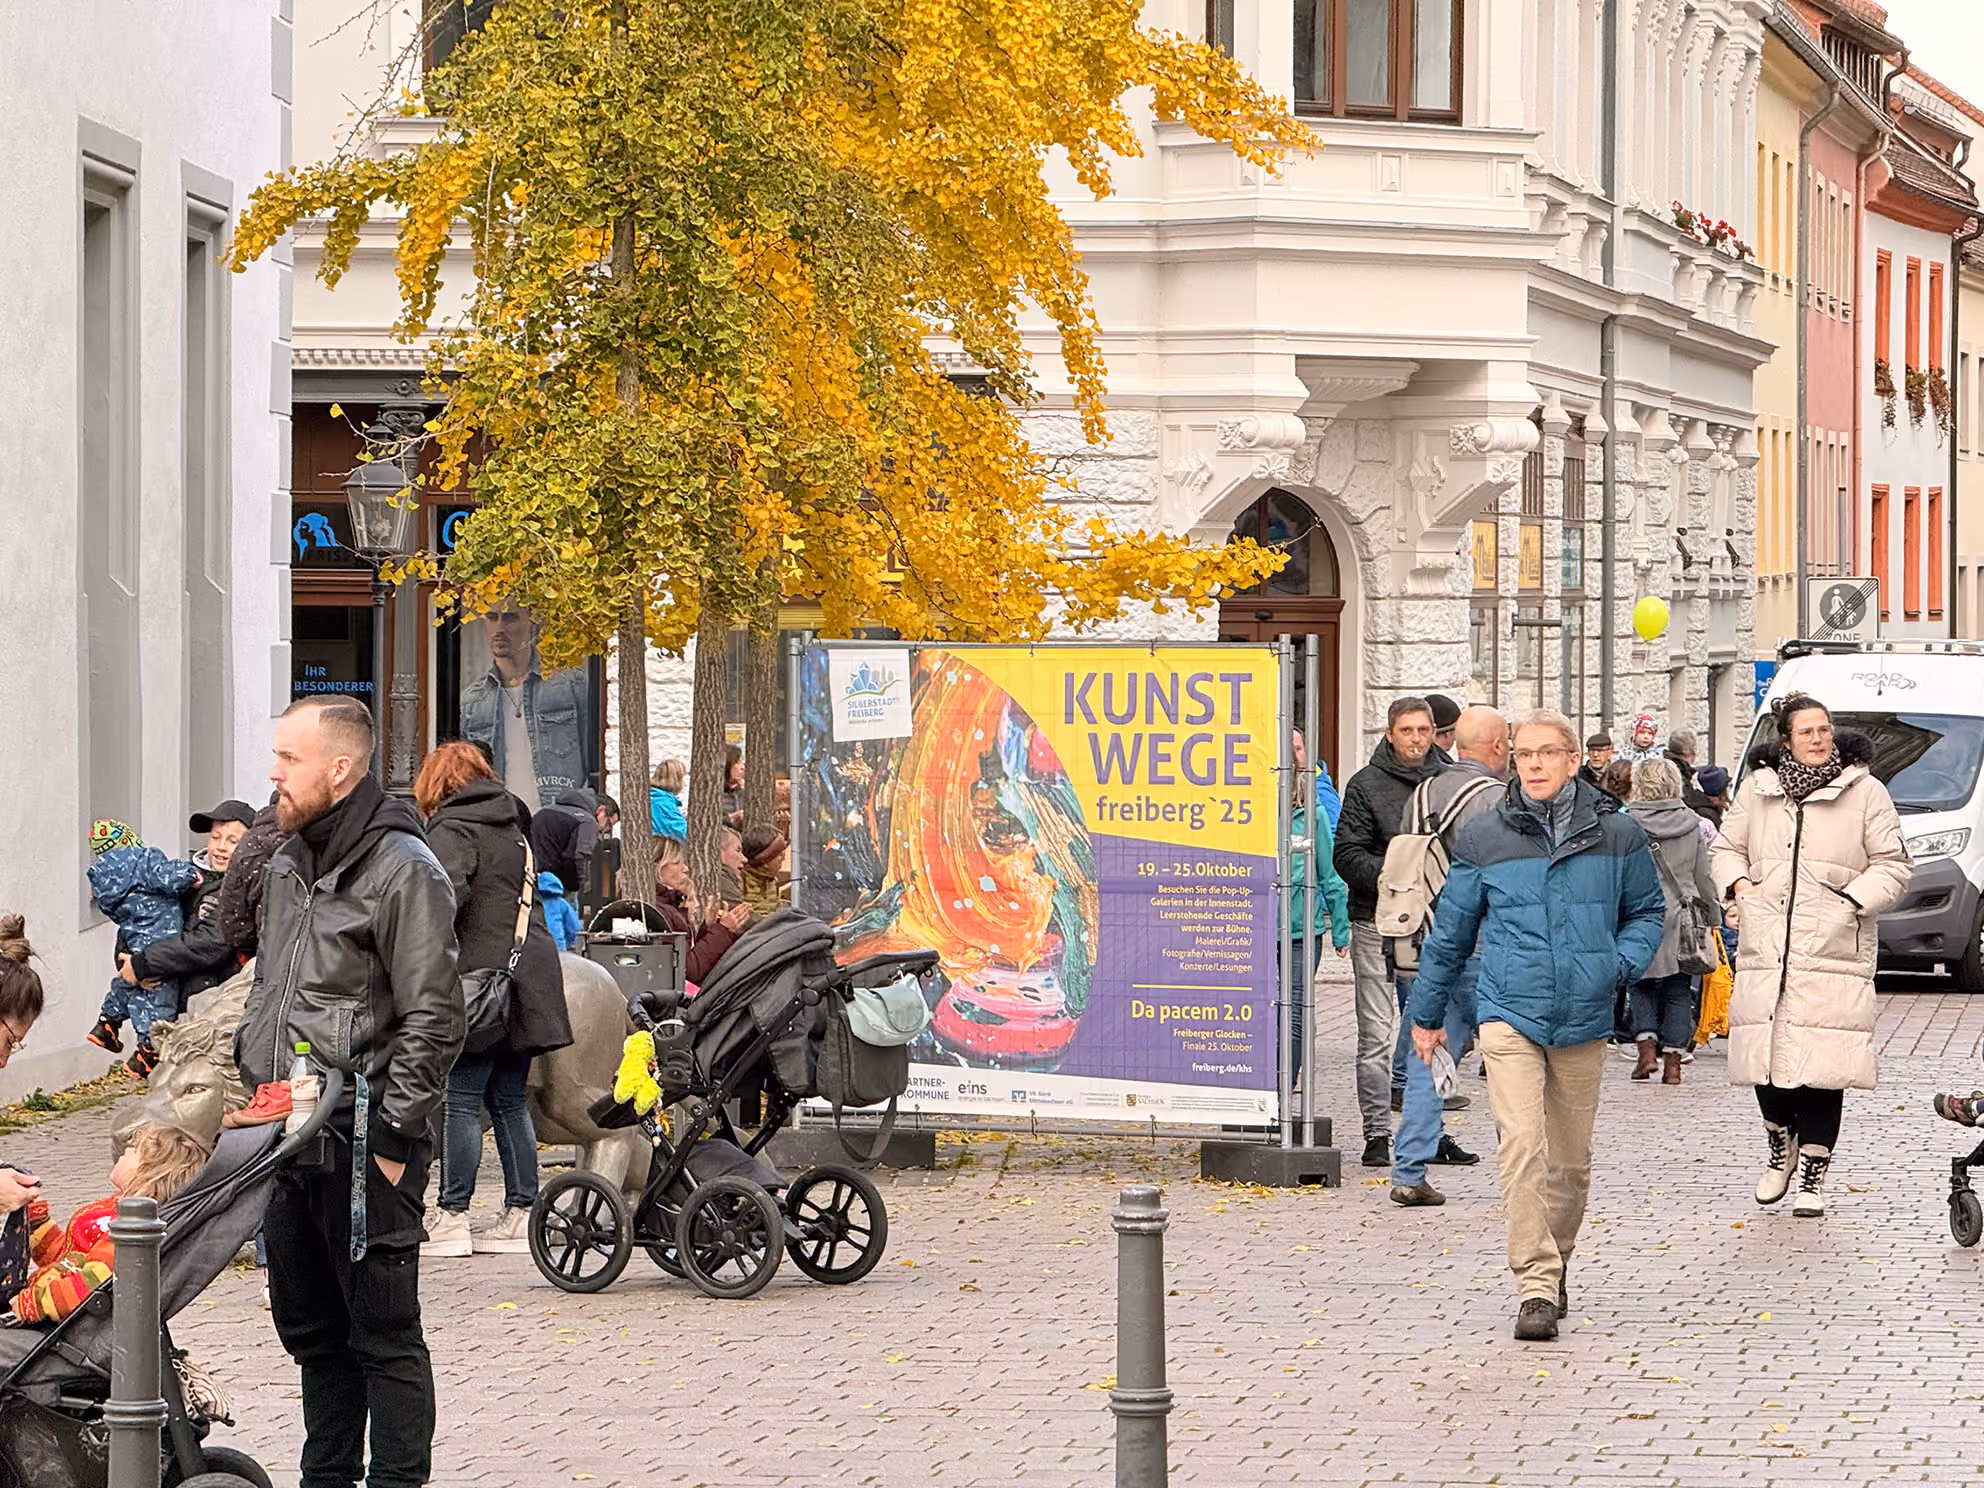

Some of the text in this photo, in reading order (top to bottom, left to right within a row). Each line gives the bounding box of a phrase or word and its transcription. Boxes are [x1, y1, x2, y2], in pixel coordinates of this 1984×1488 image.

[304, 664, 326, 677] IHR
[294, 681, 374, 692] BESONDERER
[1064, 672, 1252, 725] KUNST
[848, 708, 884, 718] FREIBERG
[1087, 732, 1252, 786] WEGE
[1137, 862, 1159, 876] 19.
[1158, 885, 1194, 894] Besuchen
[1195, 885, 1207, 894] Sie
[1209, 885, 1221, 895] die
[1150, 897, 1253, 908] Galerien in der Innenstadt.
[1160, 910, 1253, 920] Leerstehende Geschäfte
[1181, 923, 1210, 932] werden
[1226, 923, 1253, 933] Bühne.
[1180, 962, 1253, 974] Konzerte/Lesungen
[1131, 1000, 1252, 1024] Da pacem 2.0
[1173, 1028, 1214, 1040] Freiberger
[1215, 1029, 1246, 1038] Glocken
[1182, 1041, 1252, 1052] Finale 25. Oktober
[1192, 1062, 1252, 1074] freiberg.de/khs
[908, 1077, 946, 1088] ARTNER-
[958, 1080, 987, 1095] eins
